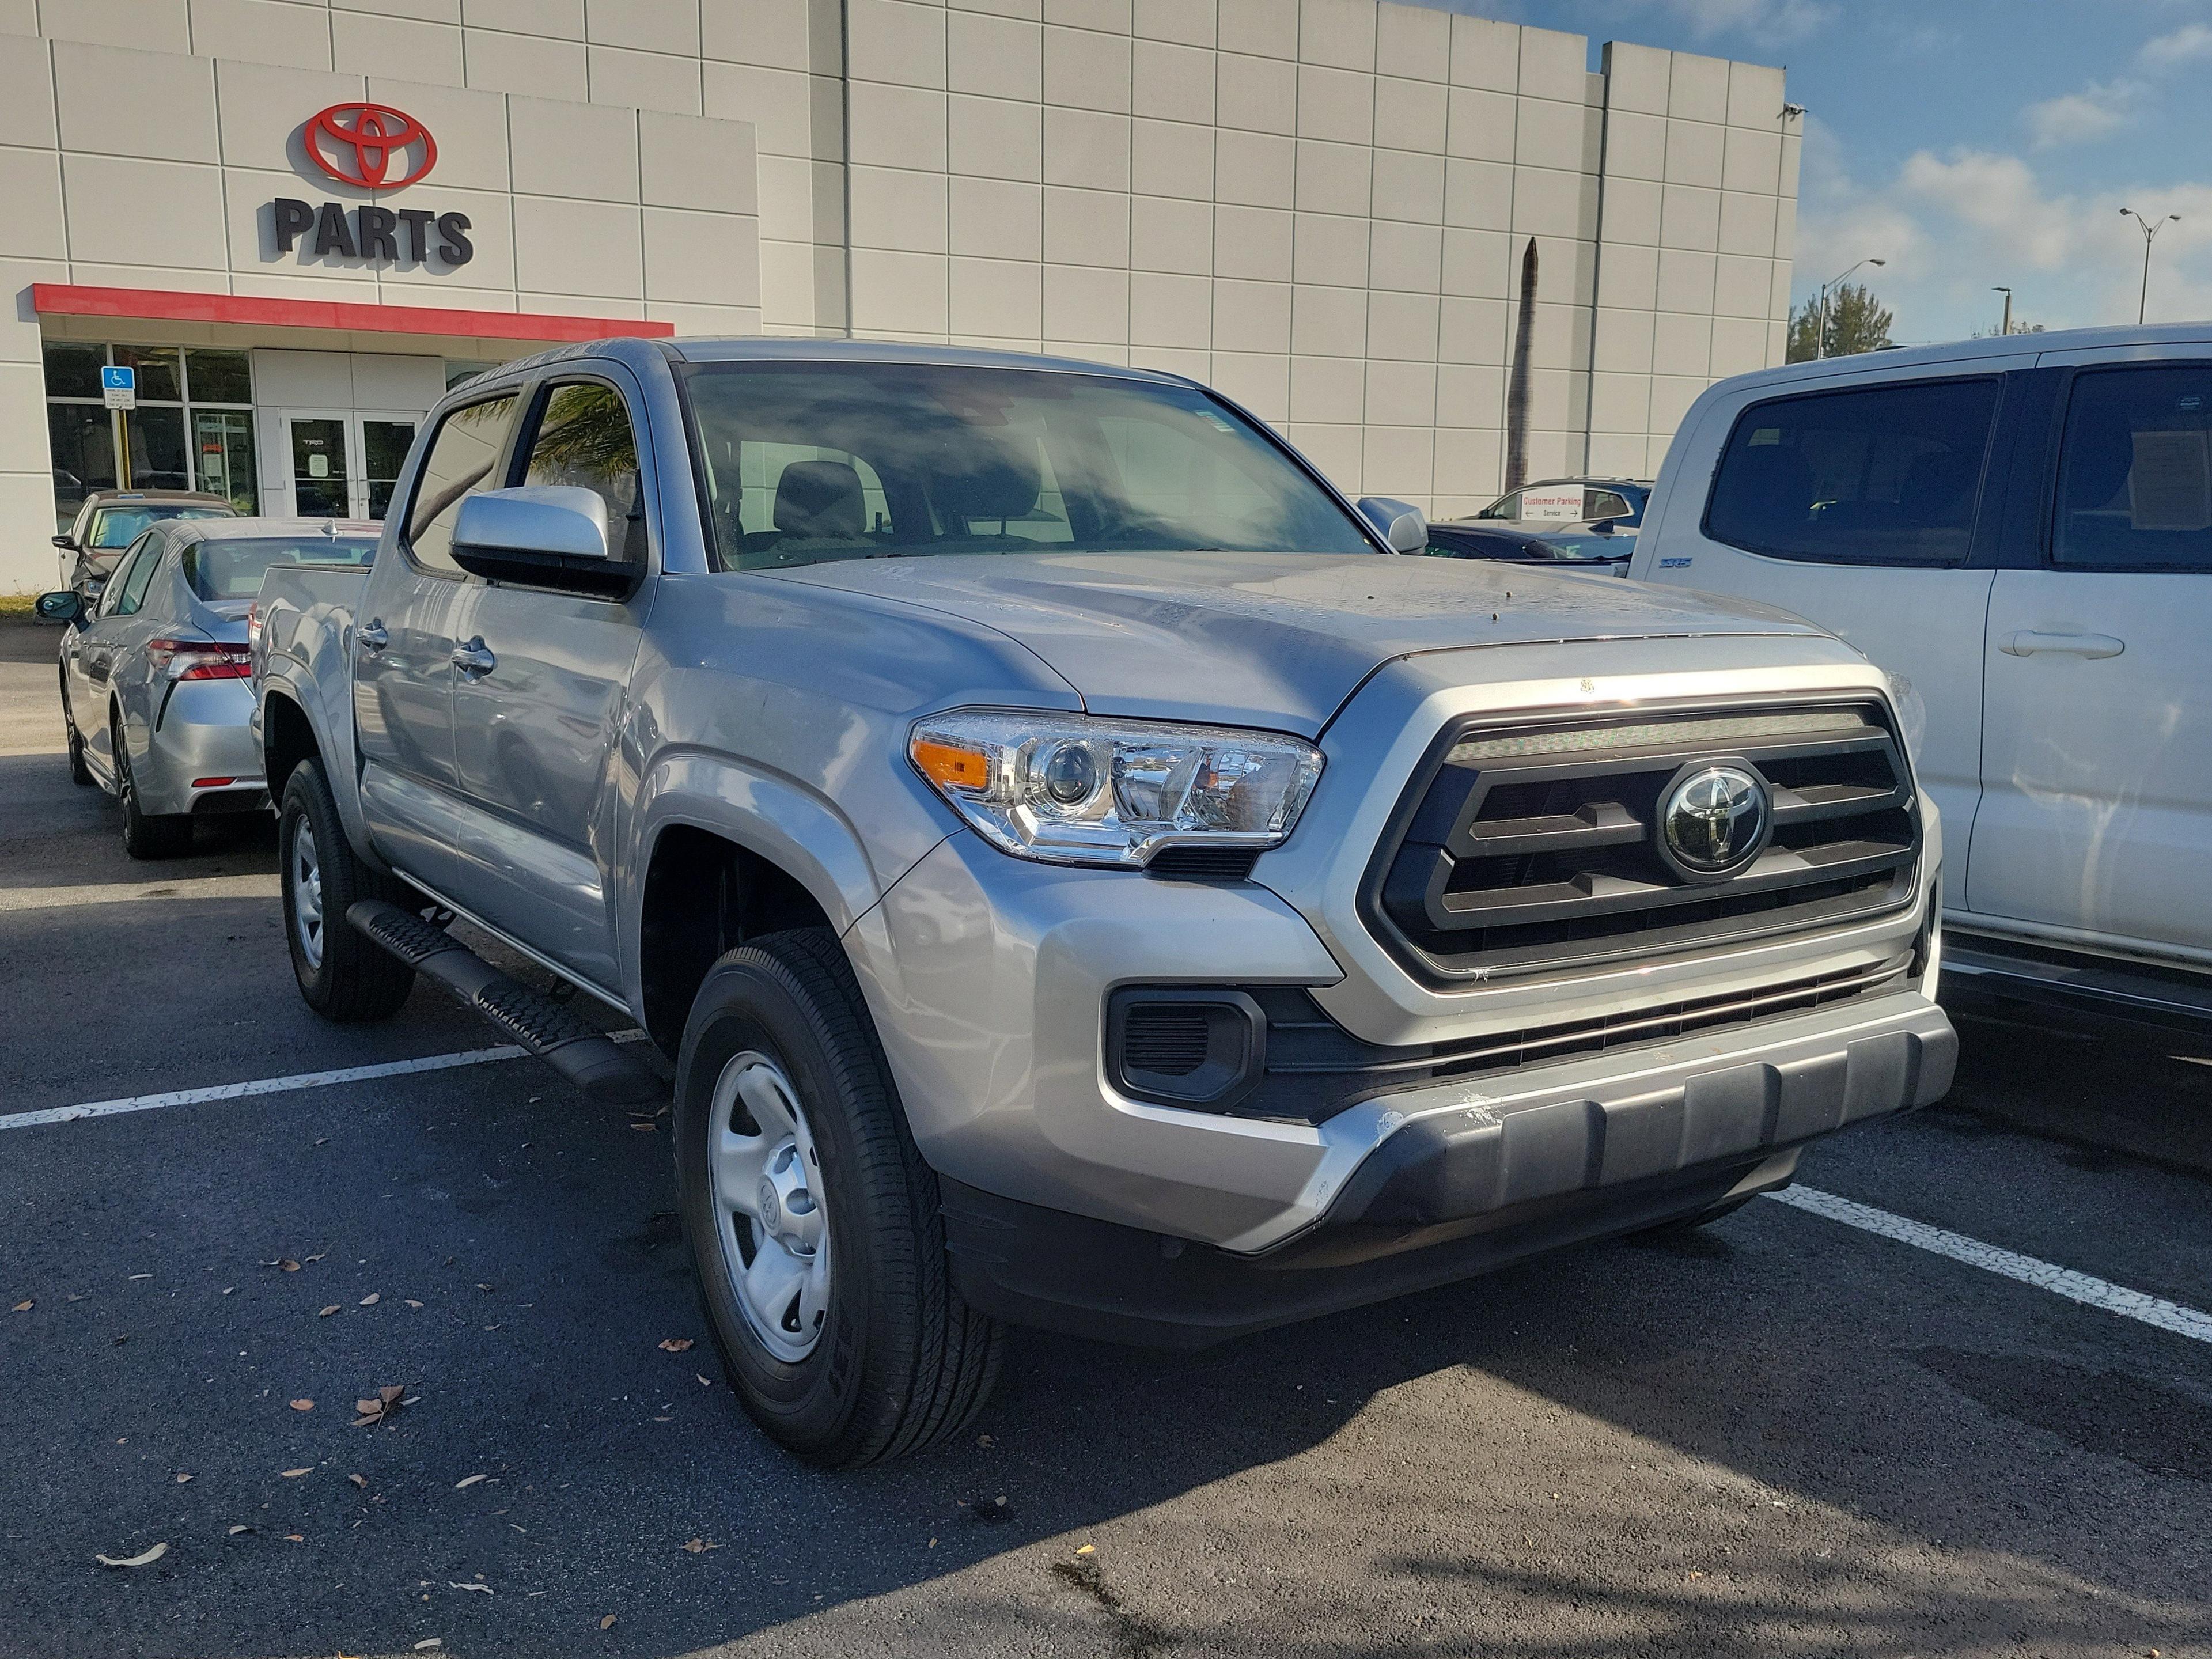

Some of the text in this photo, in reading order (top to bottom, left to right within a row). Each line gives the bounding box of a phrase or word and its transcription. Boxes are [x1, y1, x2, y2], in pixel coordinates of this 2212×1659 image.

[275, 198, 474, 265] PARTS
[1524, 497, 1581, 507] Customer Parking
